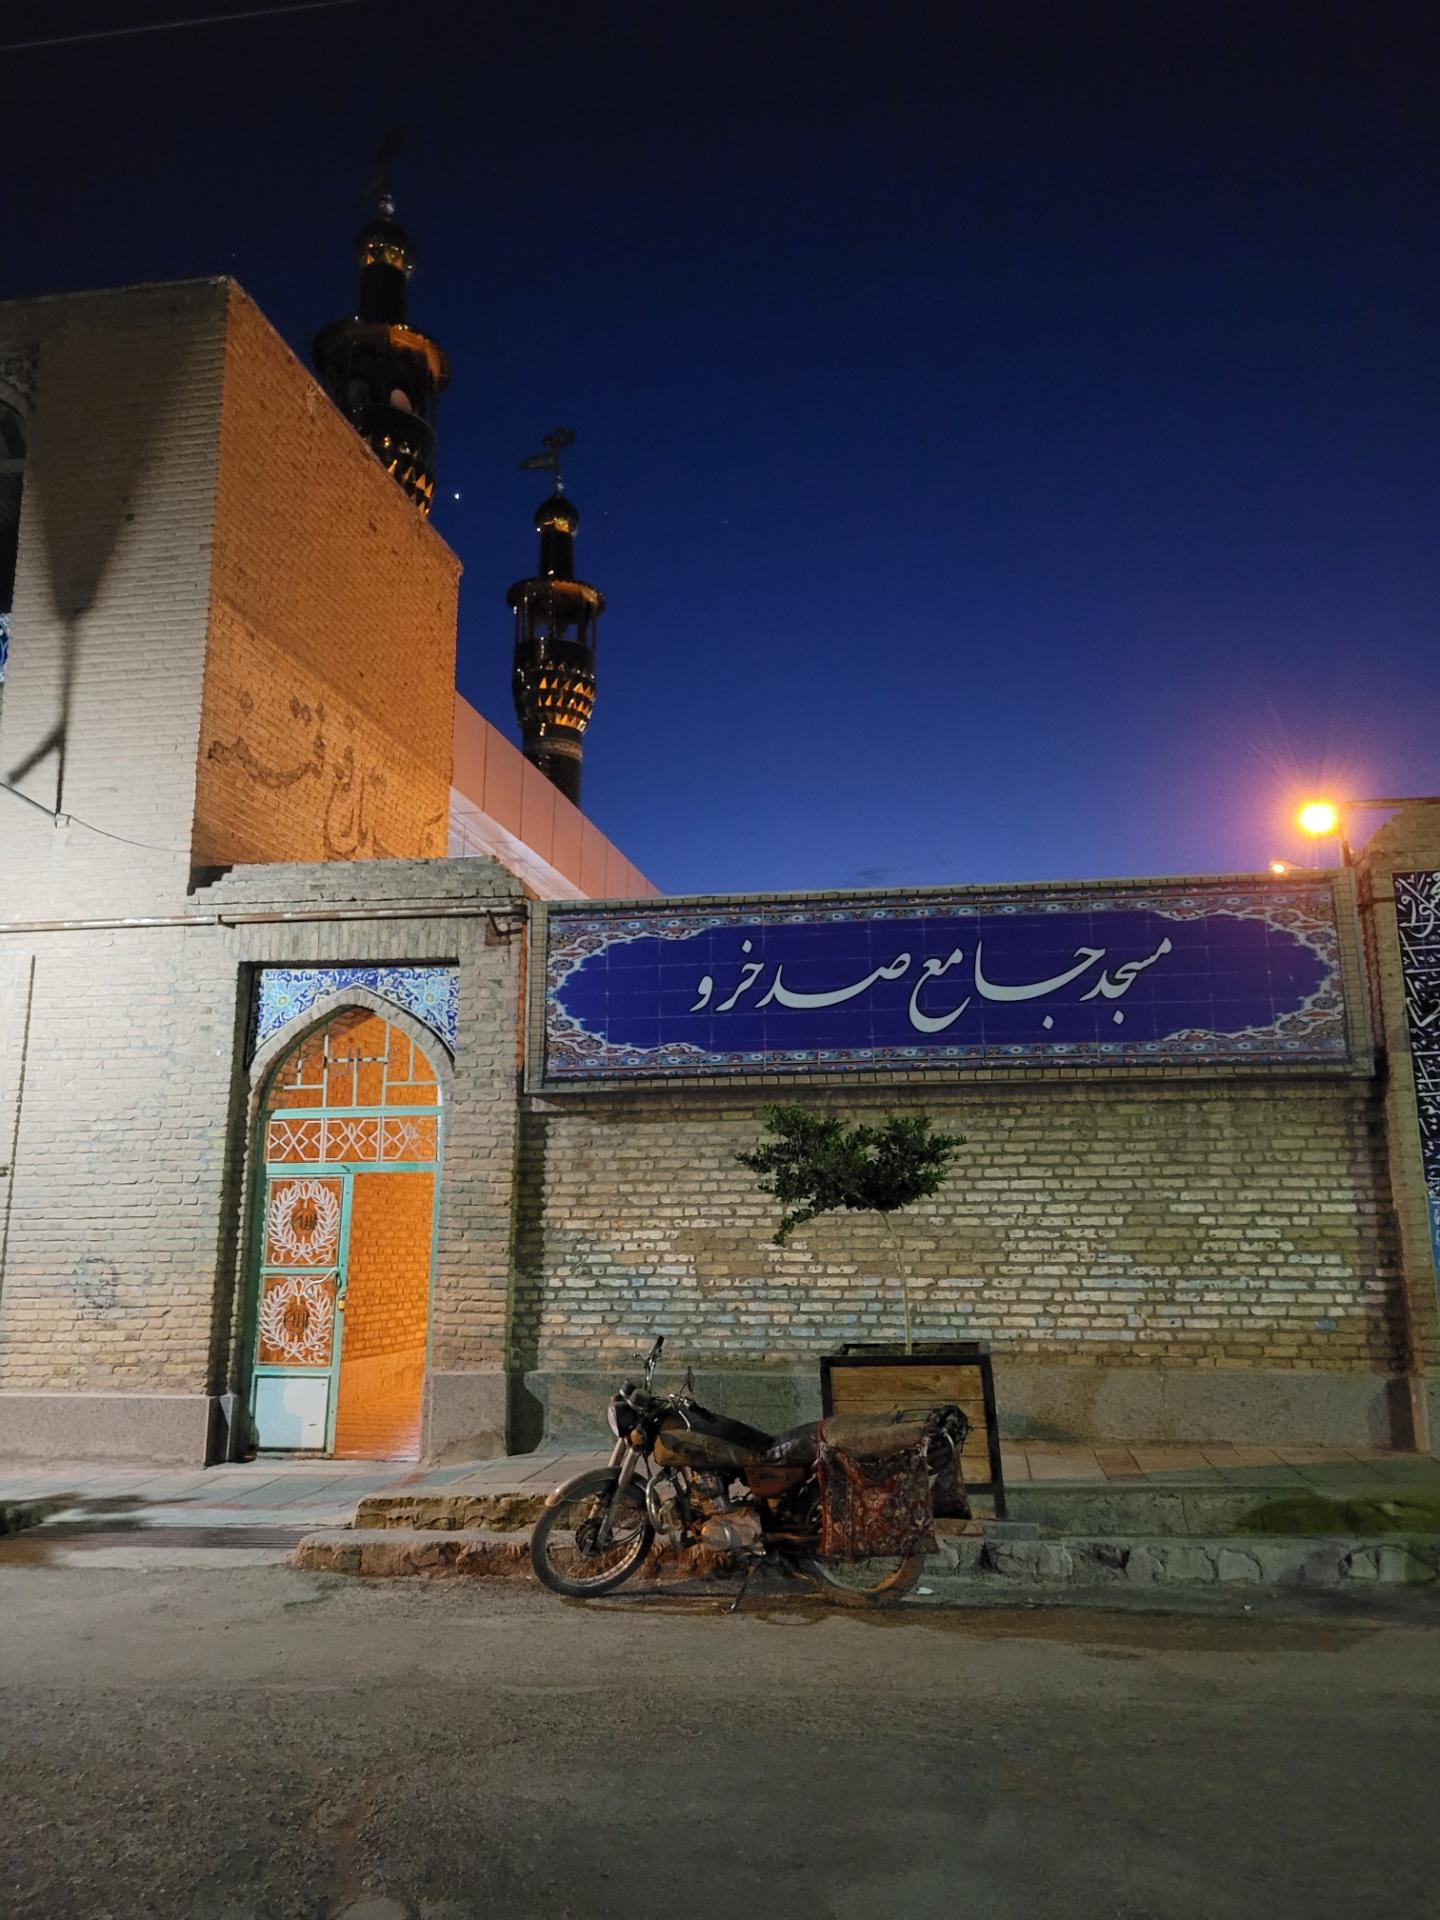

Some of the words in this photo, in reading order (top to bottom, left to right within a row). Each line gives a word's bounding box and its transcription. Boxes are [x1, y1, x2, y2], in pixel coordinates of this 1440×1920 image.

[688, 939, 912, 1013] صدخرو
[908, 939, 1106, 1034] جامع
[1078, 936, 1173, 1025] مسجد
